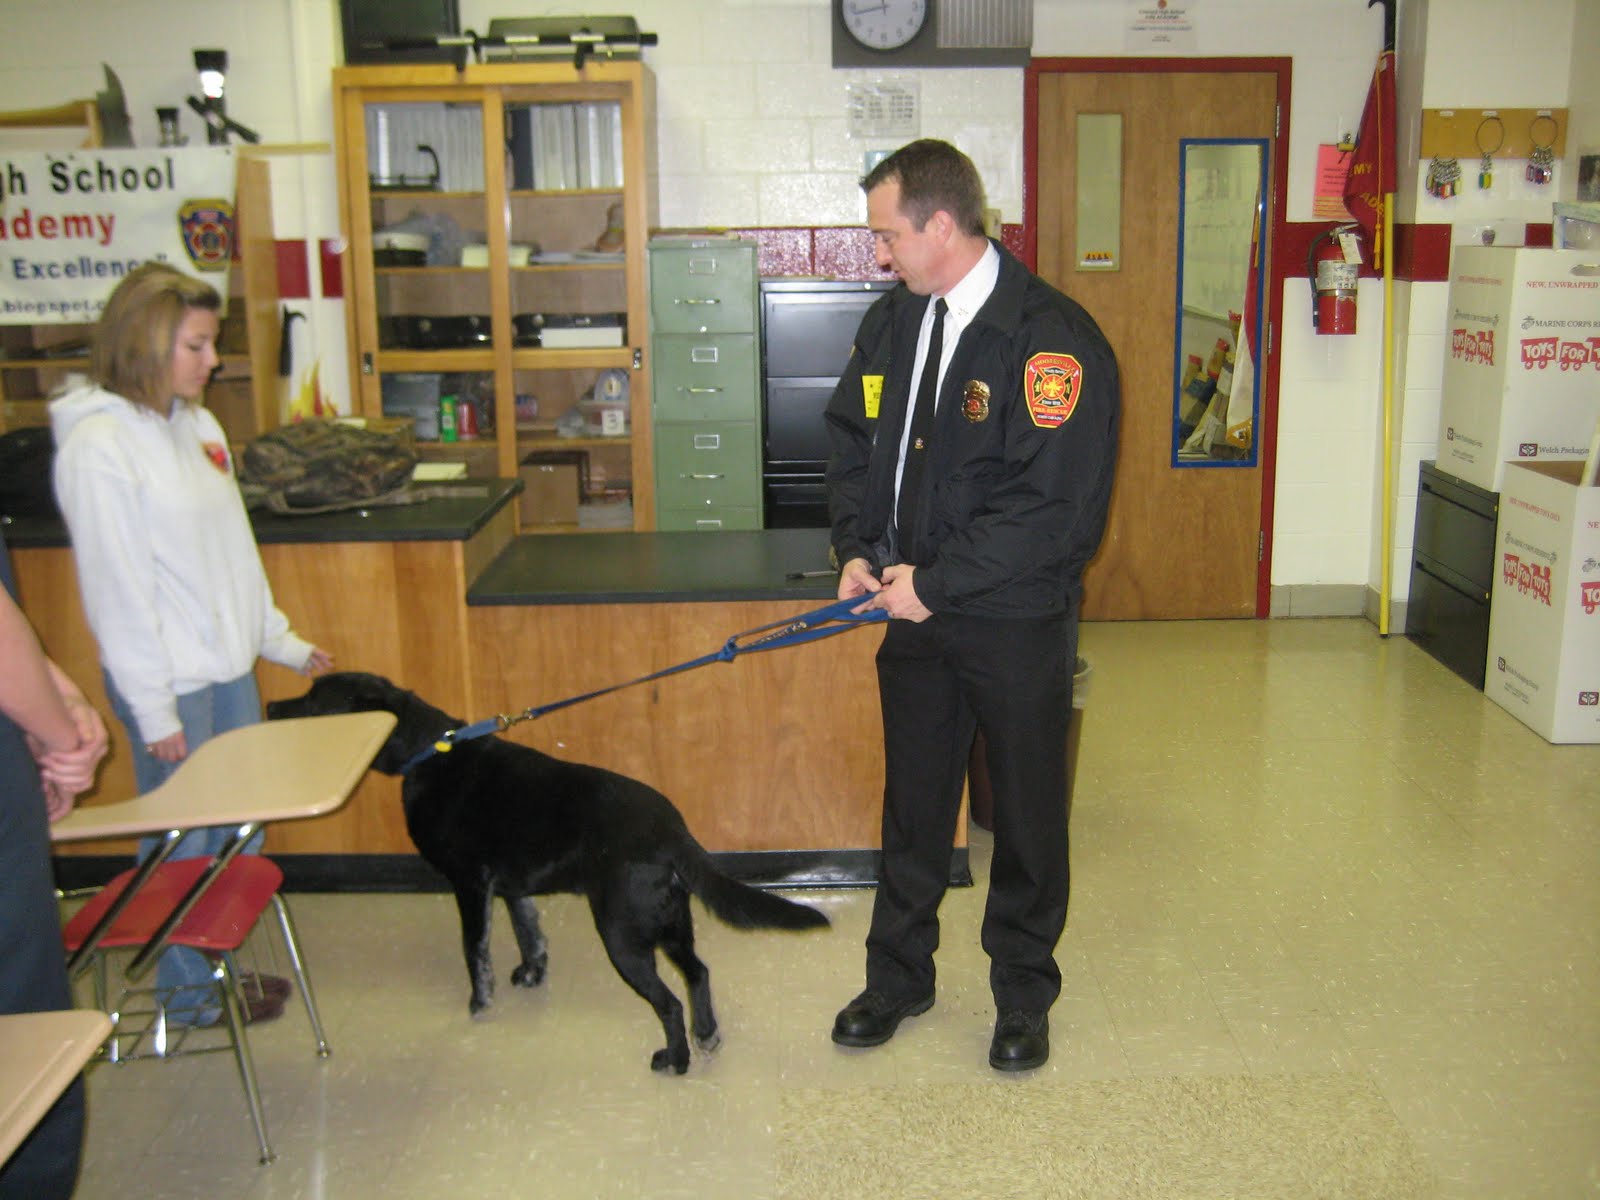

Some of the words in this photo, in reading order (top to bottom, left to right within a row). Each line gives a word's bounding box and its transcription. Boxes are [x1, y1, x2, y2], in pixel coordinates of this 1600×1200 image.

[50, 156, 175, 193] School
[1535, 320, 1566, 328] MARINE
[1567, 320, 1592, 328] CORPS
[1523, 342, 1556, 359] TOYS
[1561, 345, 1586, 361] FOR
